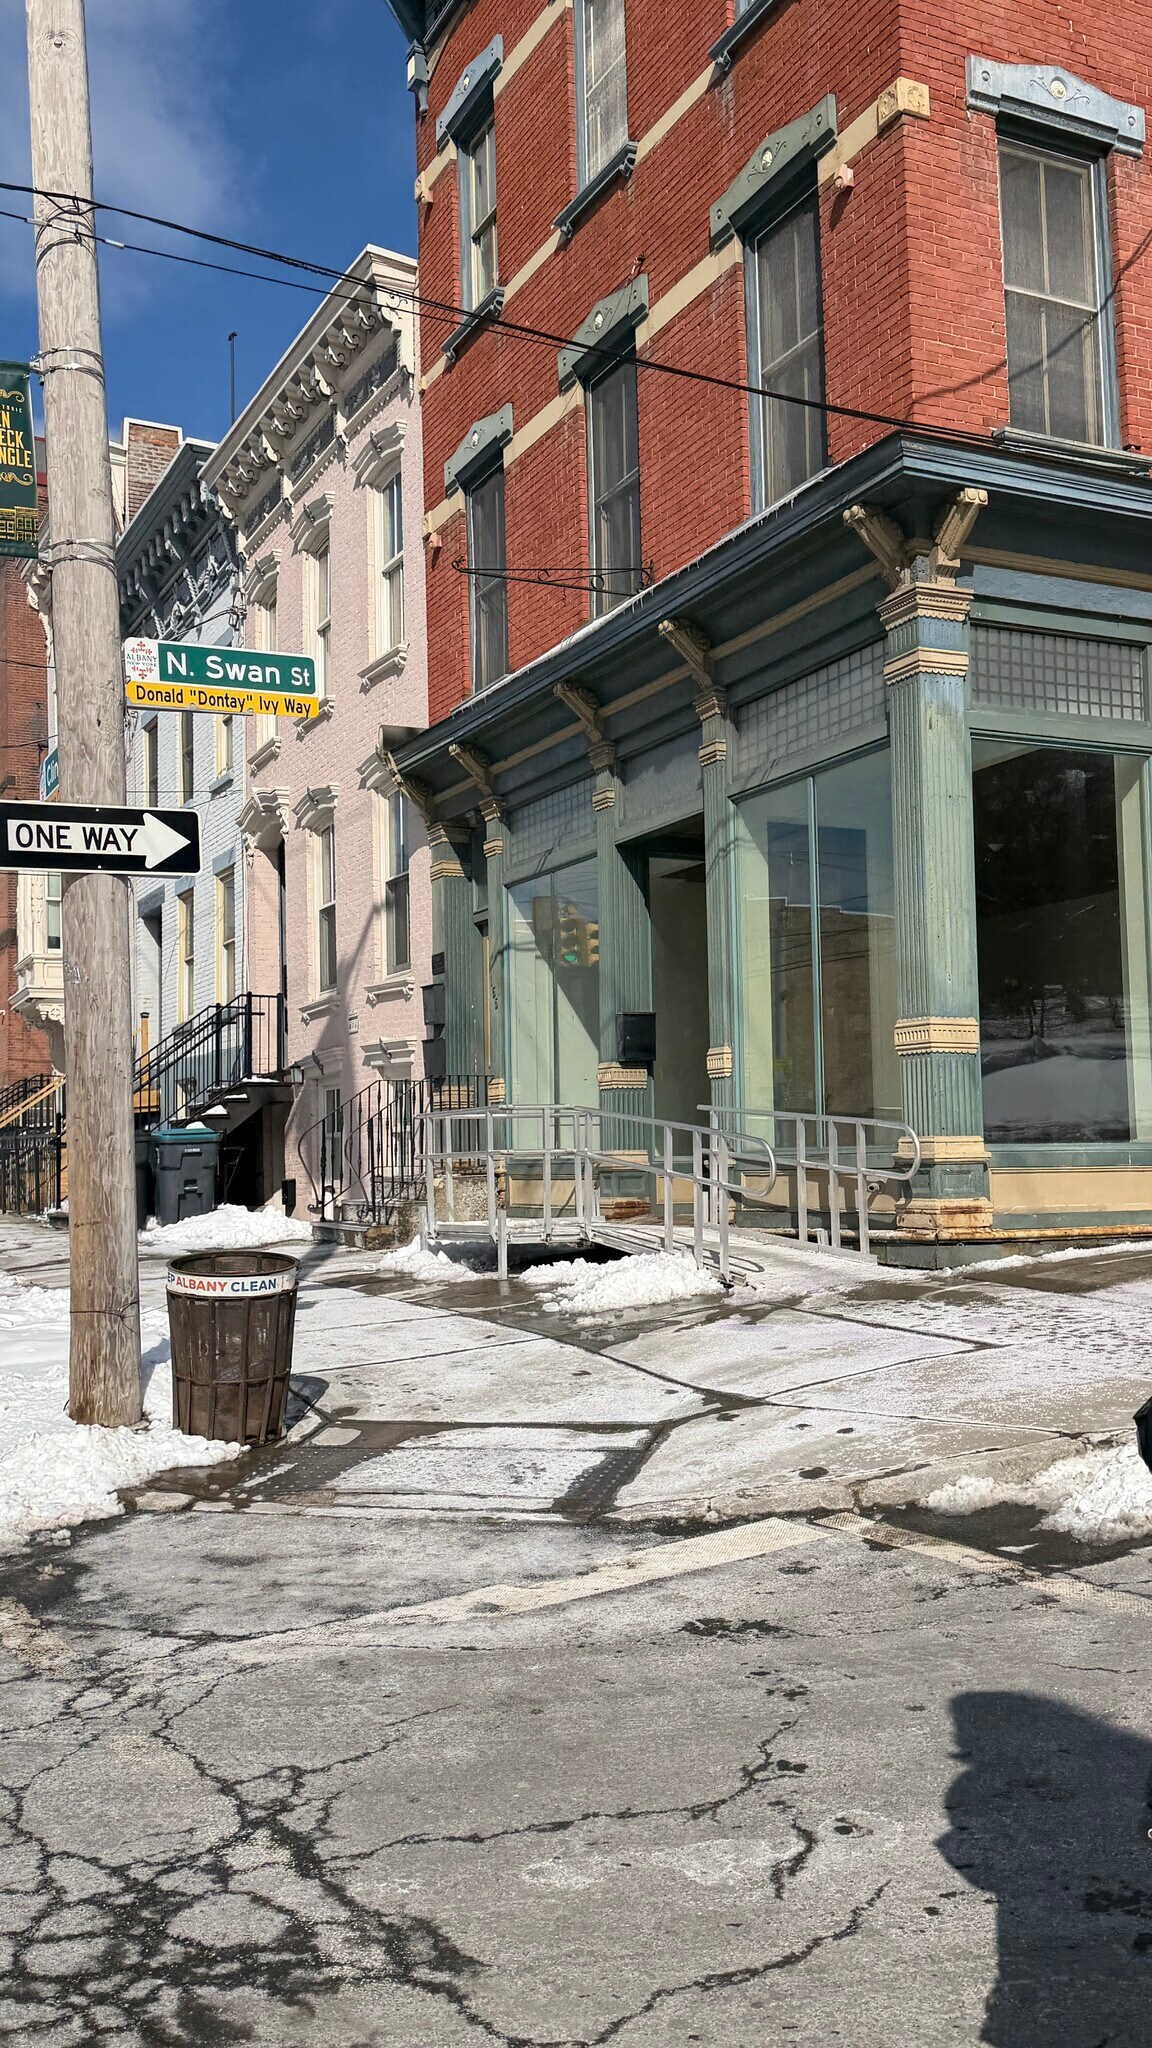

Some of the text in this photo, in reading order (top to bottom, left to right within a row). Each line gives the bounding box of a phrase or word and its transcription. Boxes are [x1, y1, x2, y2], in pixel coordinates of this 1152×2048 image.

[126, 653, 157, 662] ALBANY
[166, 651, 311, 687] N. Swan St
[136, 685, 311, 718] Donald "Dontay" Ivy Way
[15, 823, 139, 852] ONE WAY
[176, 1276, 228, 1292] ALBANY
[230, 1278, 277, 1292] CLEAN
